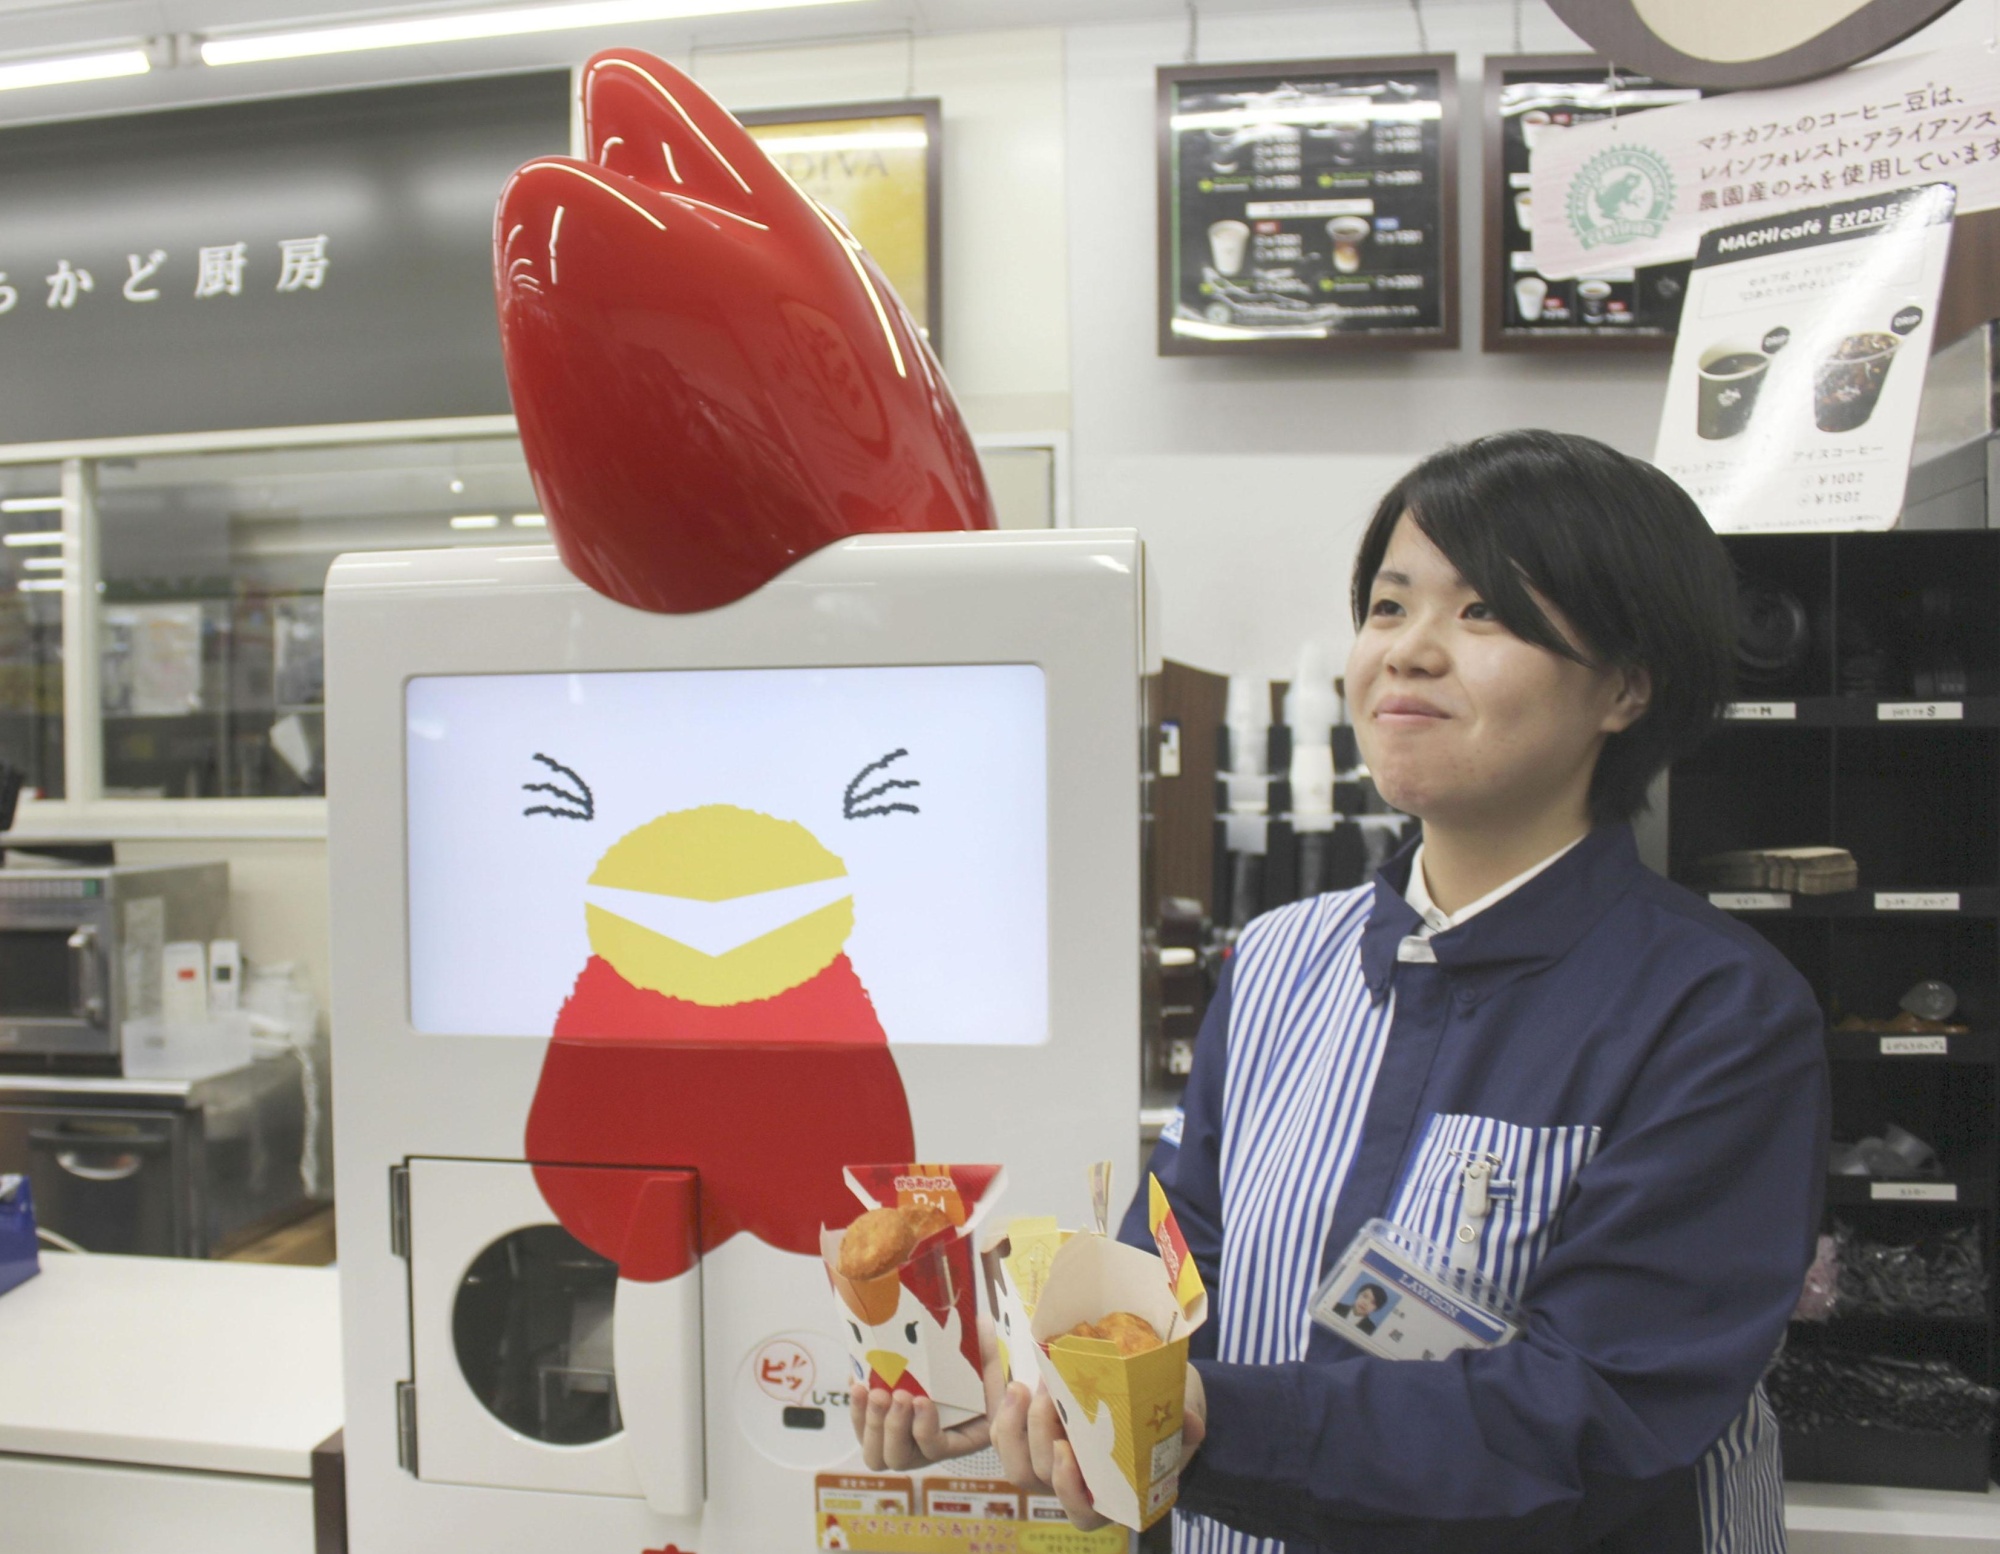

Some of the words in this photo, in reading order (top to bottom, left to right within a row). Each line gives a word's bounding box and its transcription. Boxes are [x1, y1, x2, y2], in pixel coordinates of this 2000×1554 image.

[1697, 139, 2000, 209] 農園産のみを使用しています
[1700, 111, 1997, 181] レインフォレスト・アライアンス
[1717, 221, 1822, 253] MACHIcafé
[1828, 203, 1913, 230] EXPRES
[1398, 1272, 1461, 1319] LAWSON
